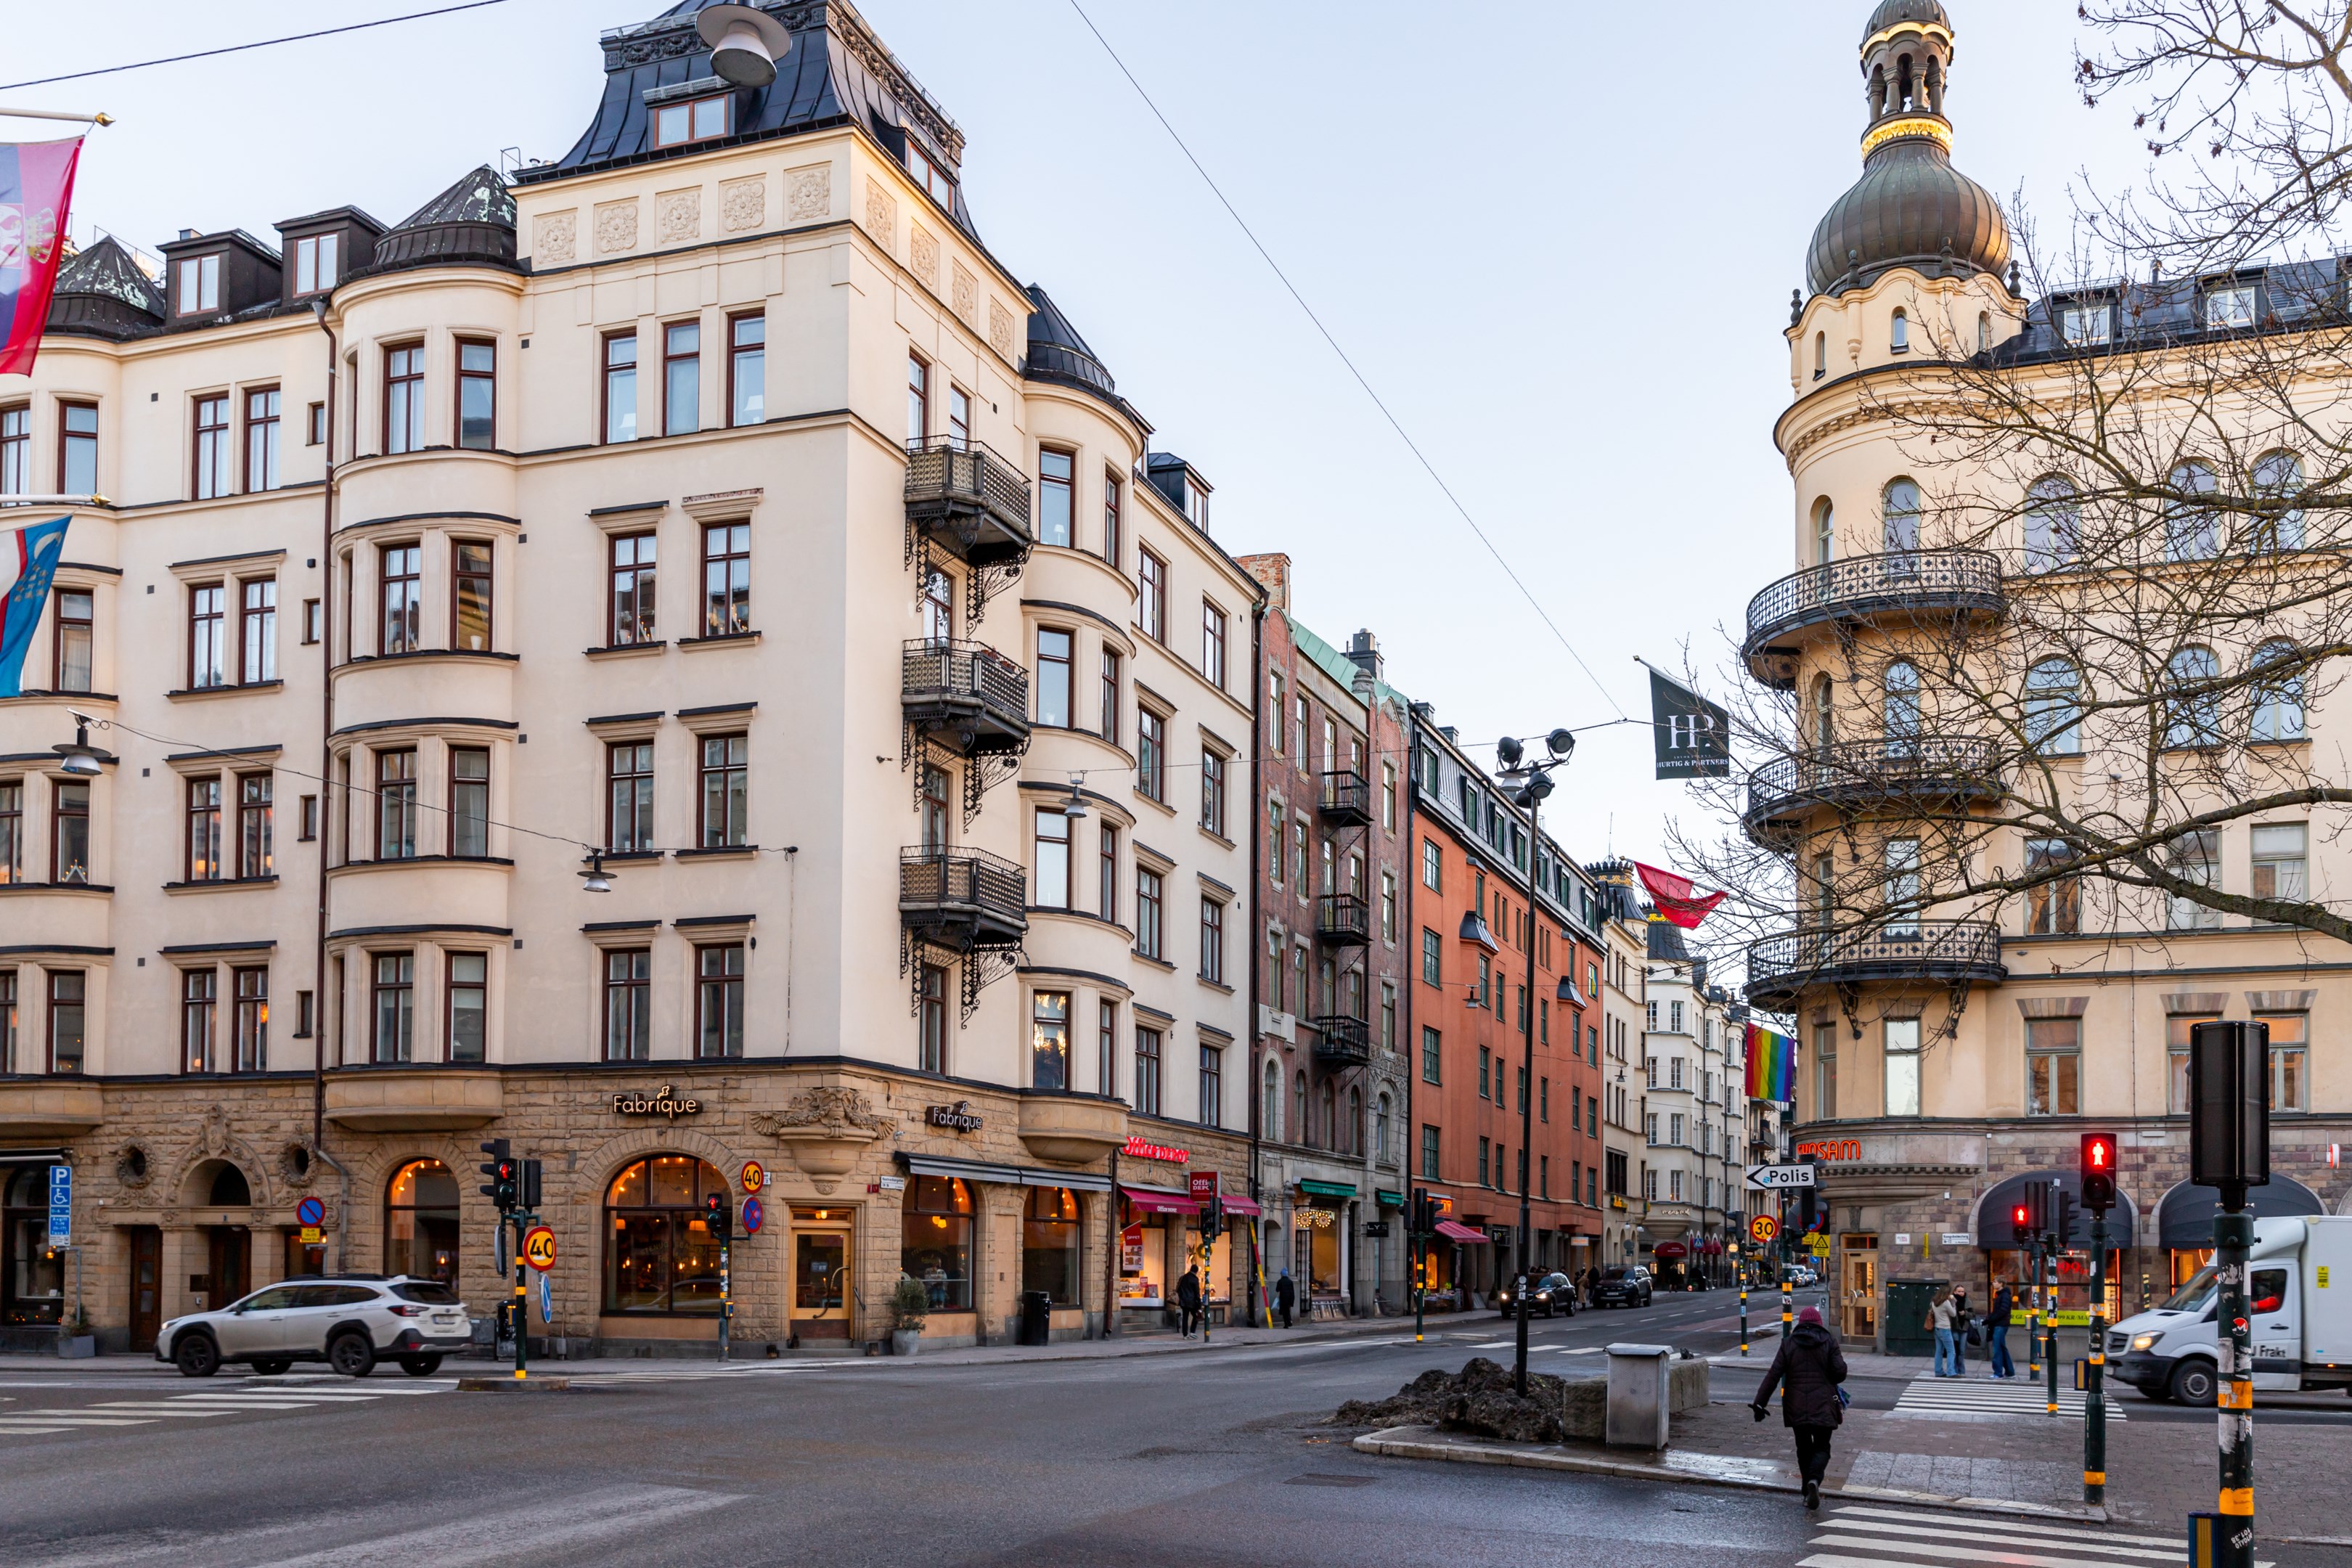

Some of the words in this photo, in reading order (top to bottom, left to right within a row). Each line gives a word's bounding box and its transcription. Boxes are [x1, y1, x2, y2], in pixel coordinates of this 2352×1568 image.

[613, 1093, 696, 1119] Fabrique
[934, 1107, 982, 1132] Fabrique
[1159, 1146, 1190, 1163] DEPOT
[56, 1168, 68, 1184] P
[745, 1169, 761, 1185] 40
[1770, 1169, 1810, 1183] Polis
[1755, 1222, 1774, 1236] 30
[530, 1238, 554, 1259] 40
[2259, 1345, 2286, 1357] Frakt
